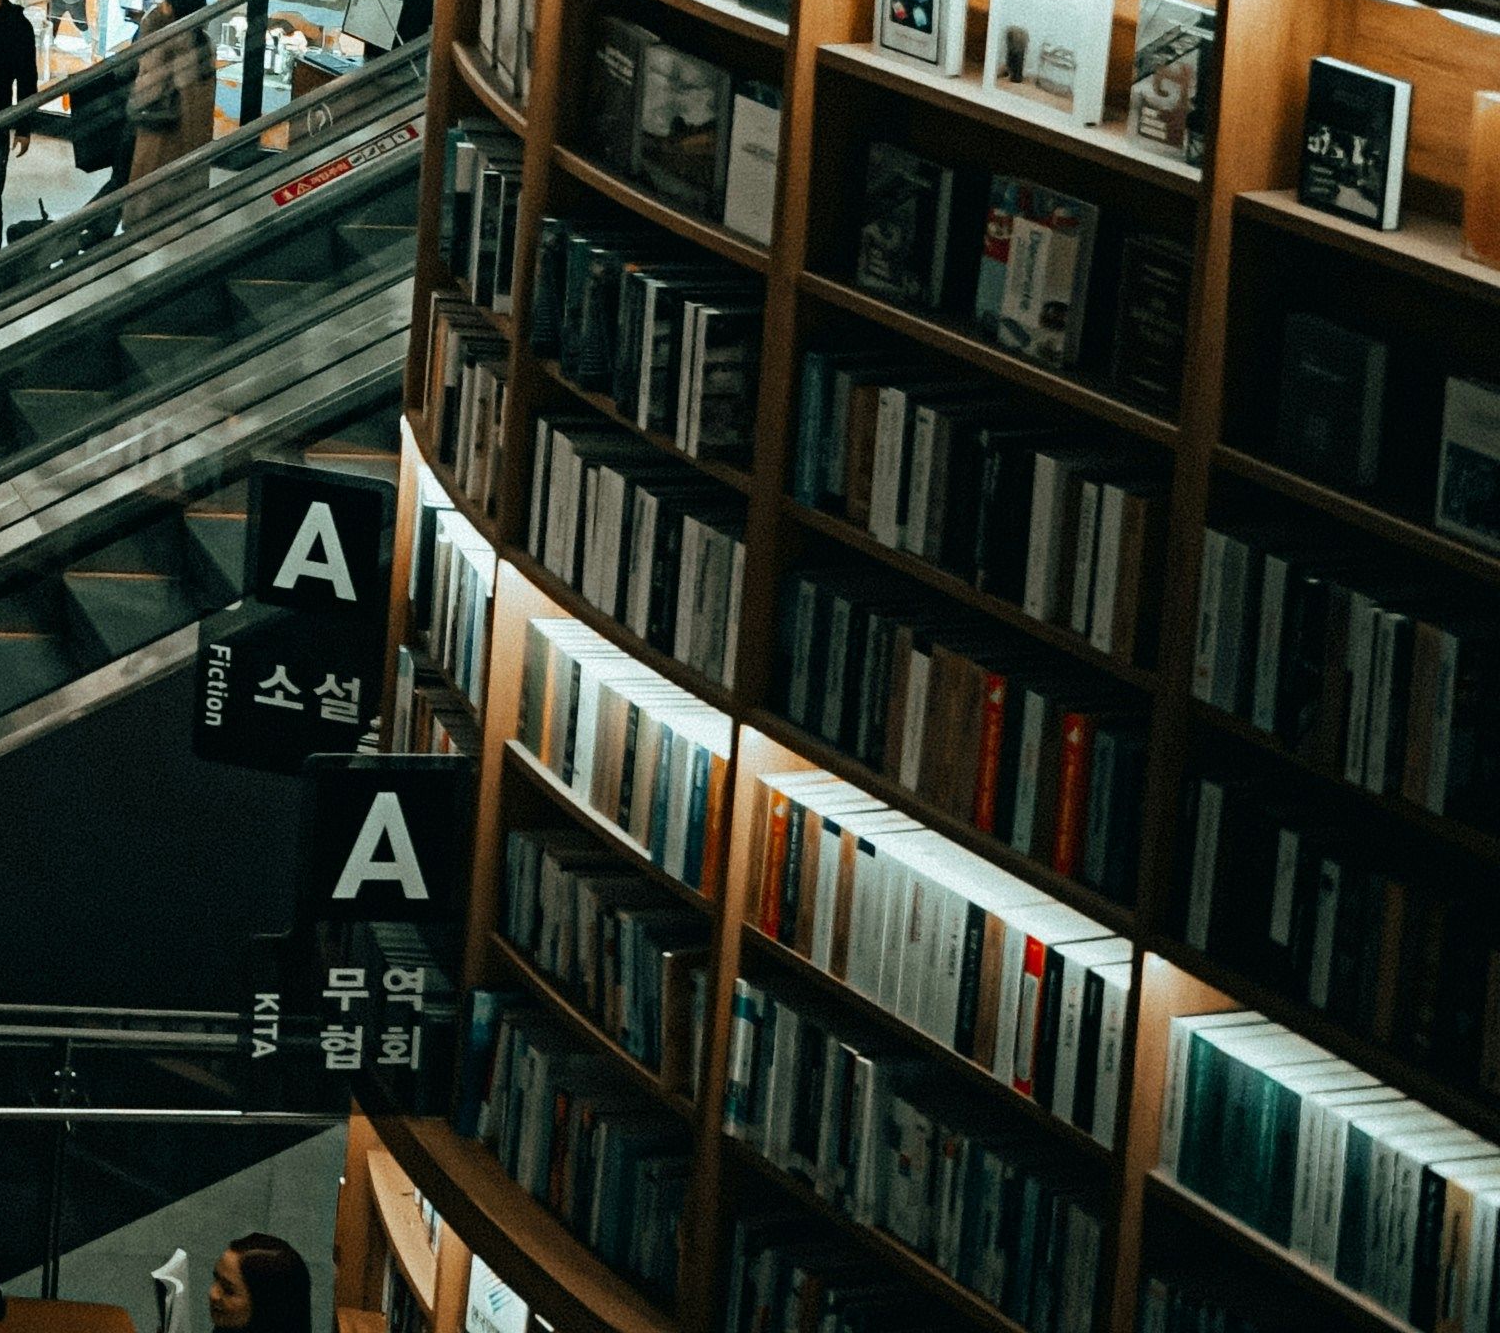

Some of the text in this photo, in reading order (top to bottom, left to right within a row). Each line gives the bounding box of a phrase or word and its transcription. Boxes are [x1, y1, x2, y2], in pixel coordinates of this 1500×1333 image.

[273, 501, 357, 602] A
[204, 643, 232, 727] Fiction
[254, 665, 361, 725] 소설
[331, 791, 430, 900] A
[322, 966, 425, 1013] 무역
[252, 993, 281, 1059] KITA
[319, 1024, 421, 1071] 협회
